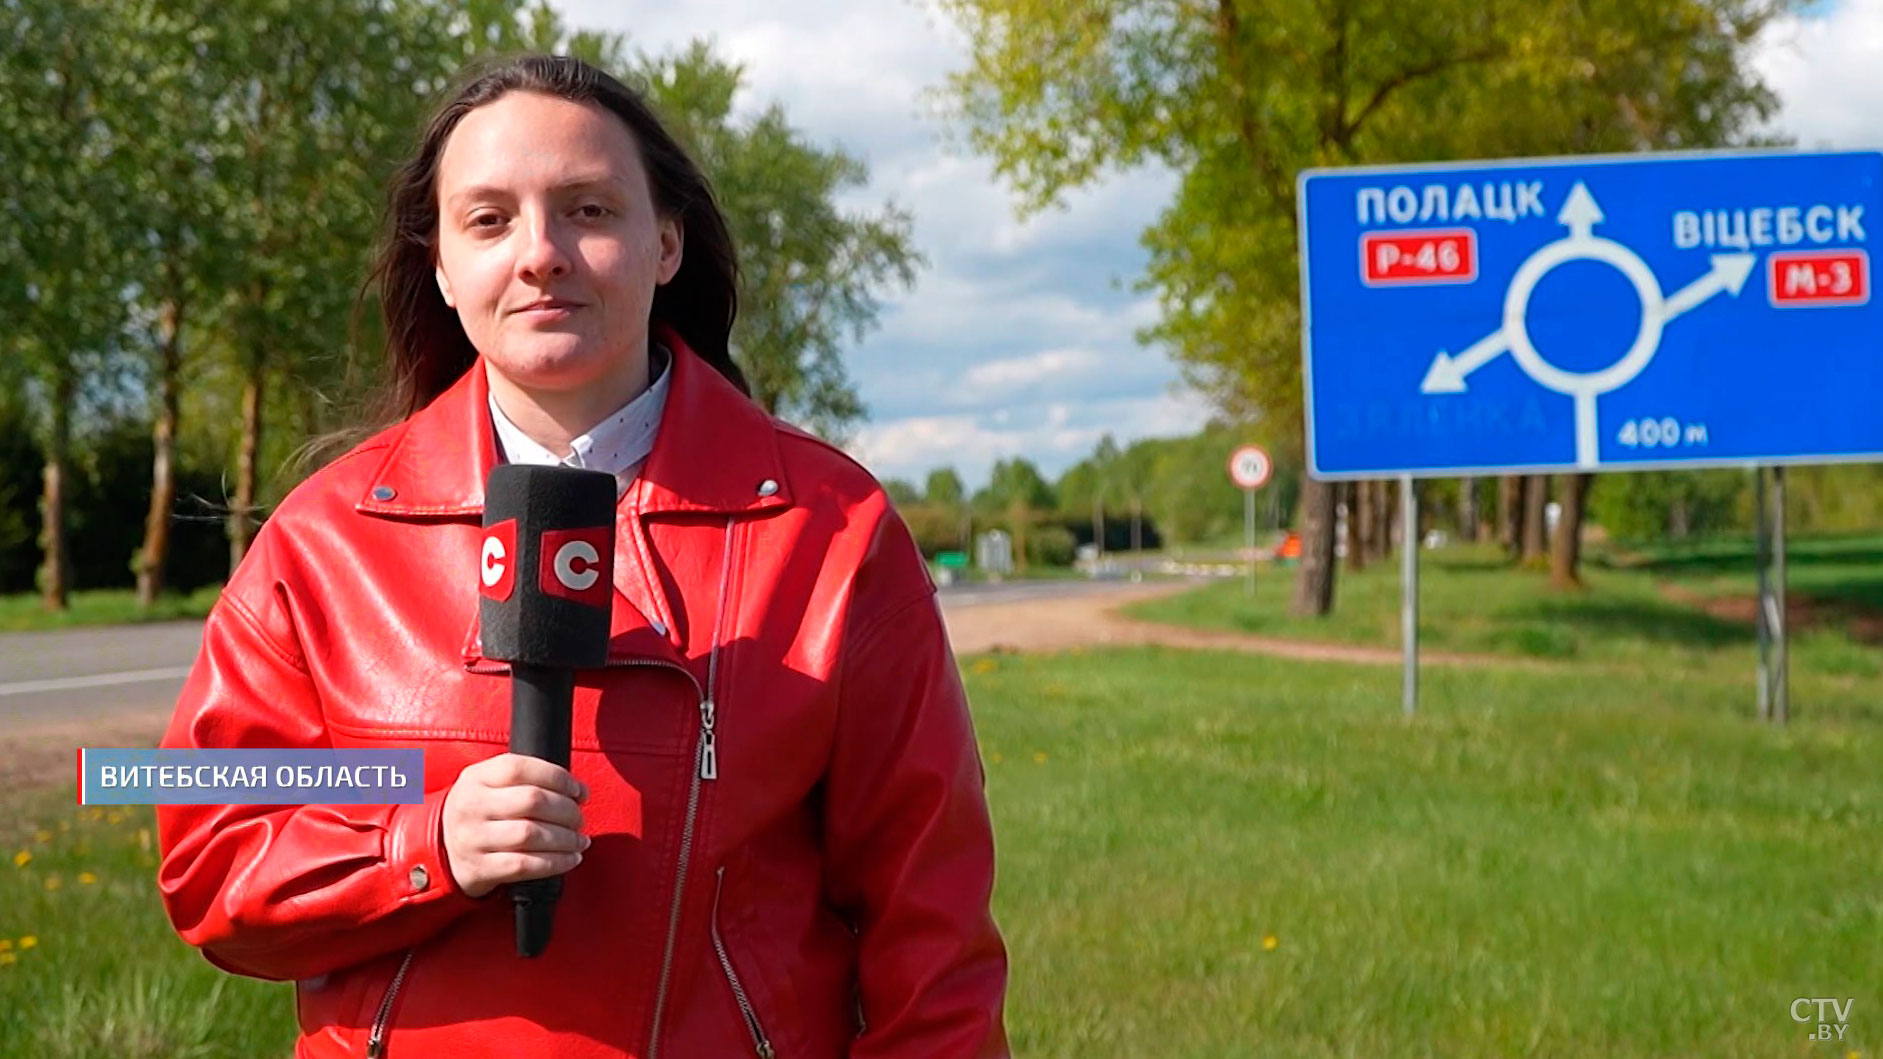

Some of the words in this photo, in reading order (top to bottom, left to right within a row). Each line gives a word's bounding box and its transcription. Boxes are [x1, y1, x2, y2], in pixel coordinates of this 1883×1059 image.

[1356, 181, 1546, 225] ПОЛАЦК
[1673, 203, 1867, 252] ВІЦЕБСК
[1376, 240, 1461, 275] Р-46
[1784, 261, 1853, 296] М-3
[1616, 416, 1681, 448] 400
